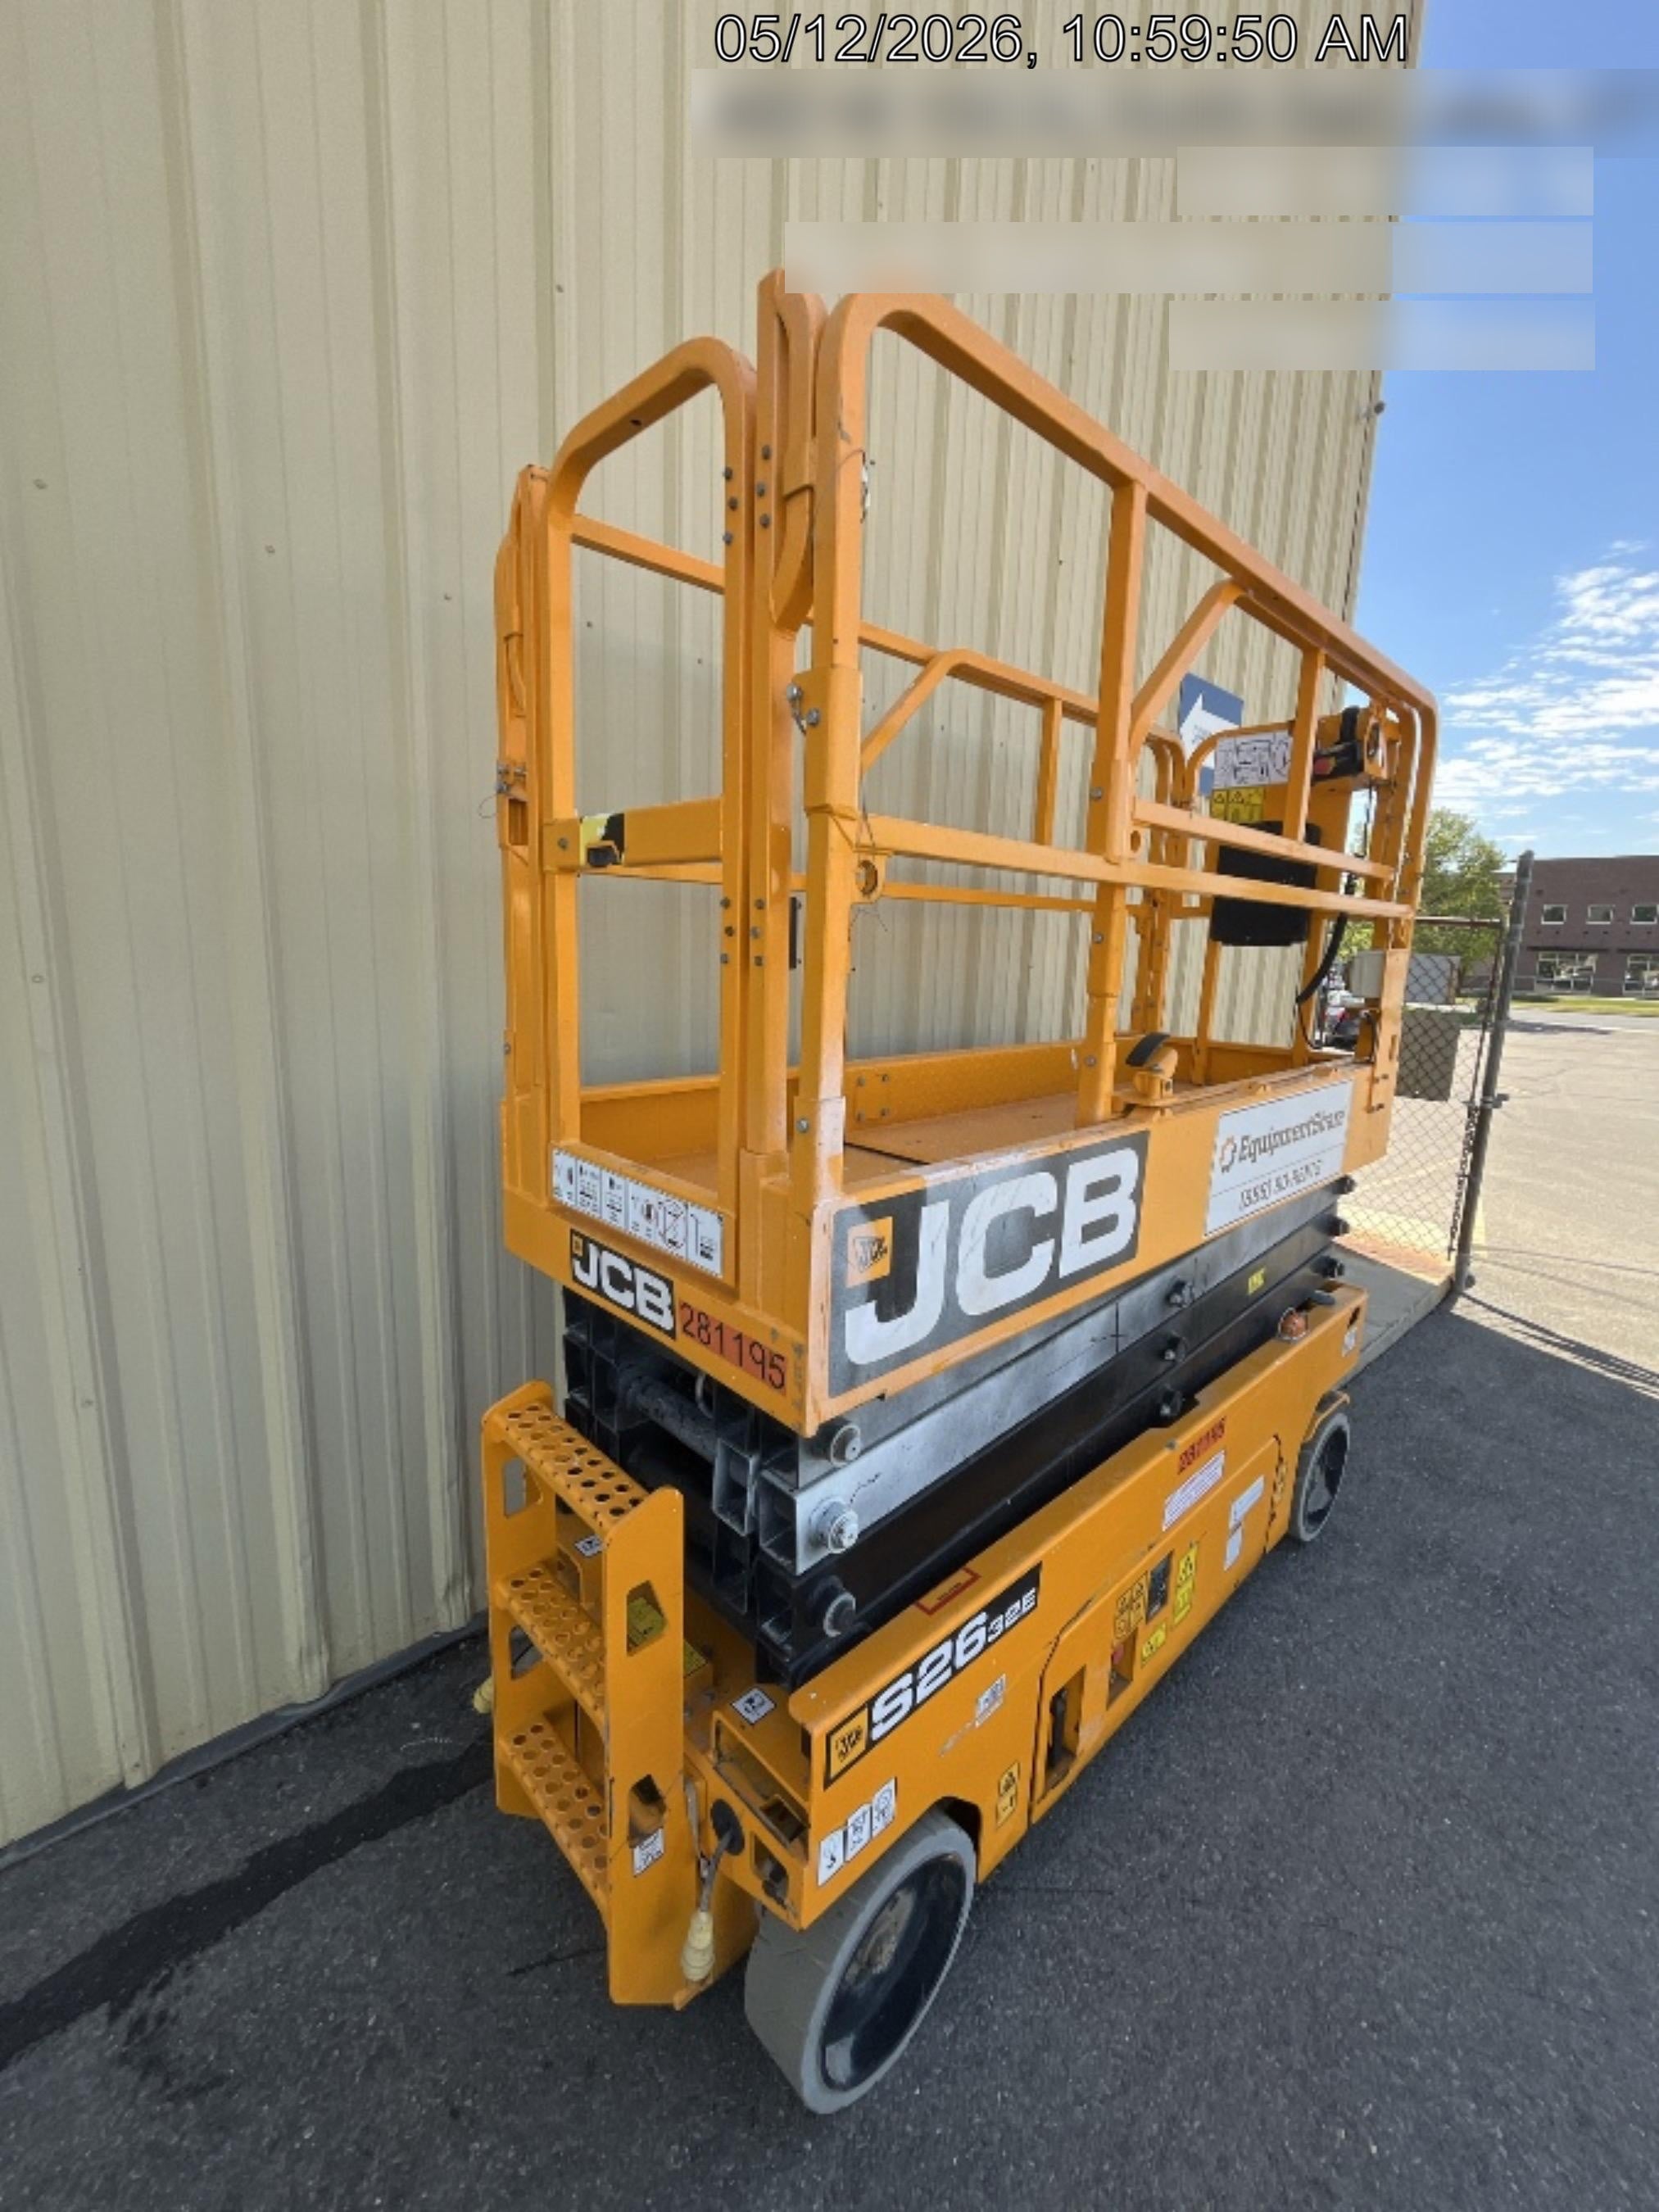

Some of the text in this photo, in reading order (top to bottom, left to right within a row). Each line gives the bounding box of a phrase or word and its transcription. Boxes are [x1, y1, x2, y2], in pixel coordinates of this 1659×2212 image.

[1238, 1109, 1345, 1163] EquipmentShare
[573, 1242, 674, 1331] JCB
[845, 1147, 1139, 1365] JCB
[681, 1302, 786, 1389] 281195
